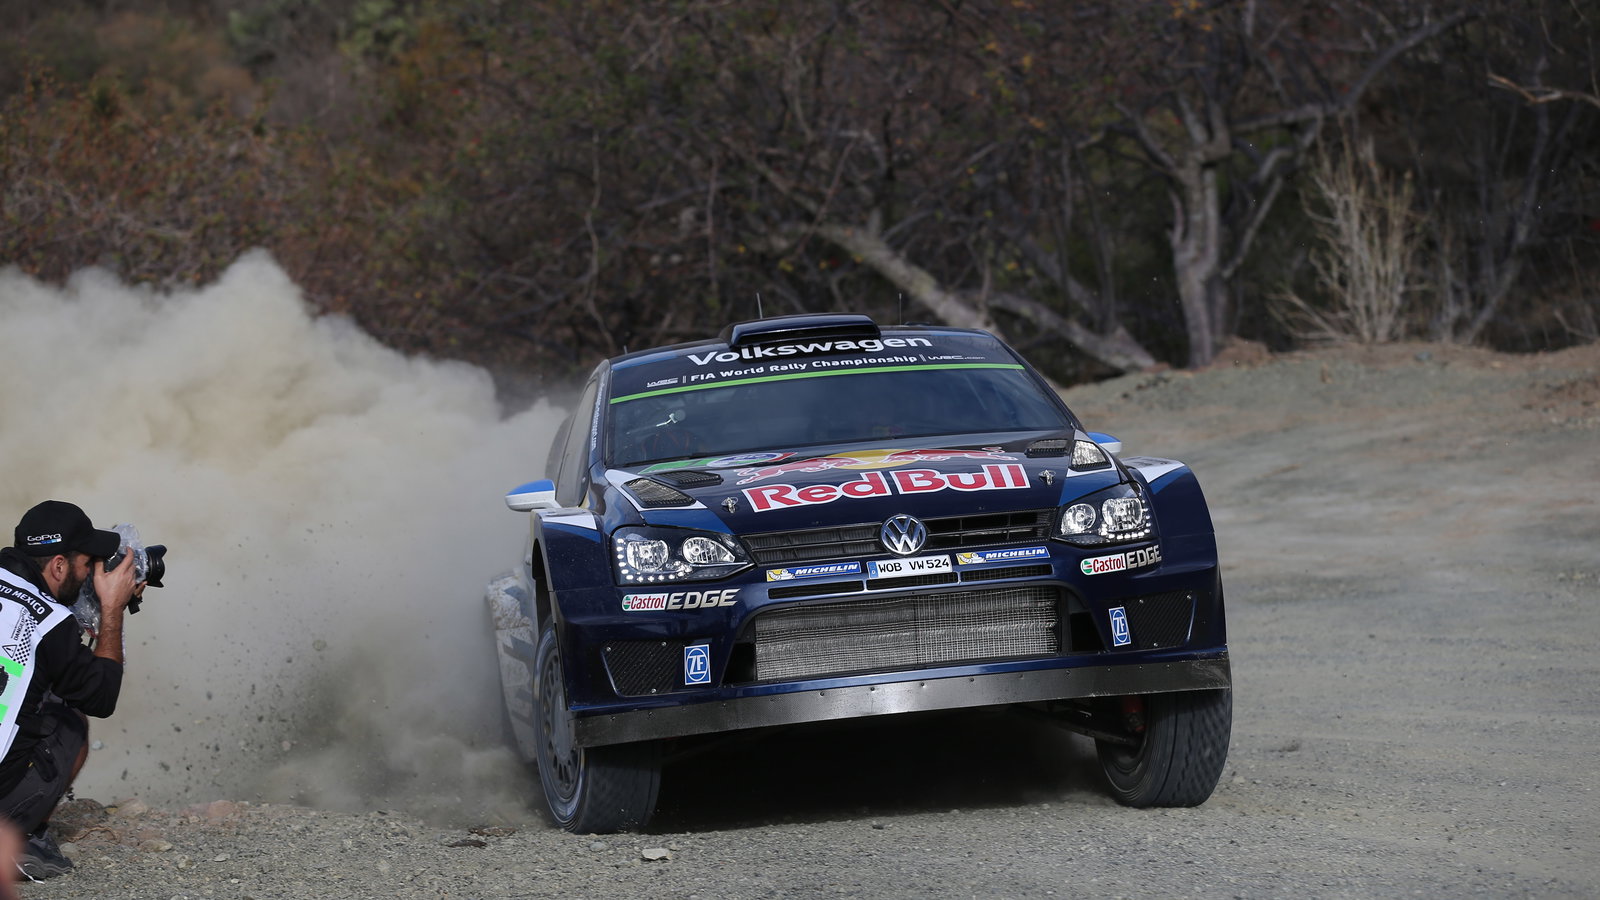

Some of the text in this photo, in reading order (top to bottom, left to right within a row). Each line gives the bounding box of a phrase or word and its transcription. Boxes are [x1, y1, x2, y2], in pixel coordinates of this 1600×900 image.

[687, 337, 933, 366] Volkswagen
[690, 373, 716, 382] FIA
[720, 366, 764, 378] World
[769, 362, 807, 372] Rally
[812, 355, 918, 368] Championship
[744, 464, 1029, 511] Red Bull
[27, 533, 62, 541] GoPro
[985, 548, 1045, 559] MICHELIN
[1093, 544, 1162, 573] Castrol EDGE
[795, 563, 858, 575] MICHELIN
[878, 562, 902, 573] WOB
[0, 585, 45, 615] TO MEXICO
[630, 588, 741, 610] Castrol EDGE
[1112, 616, 1128, 637] ZF
[688, 654, 707, 675] ZF
